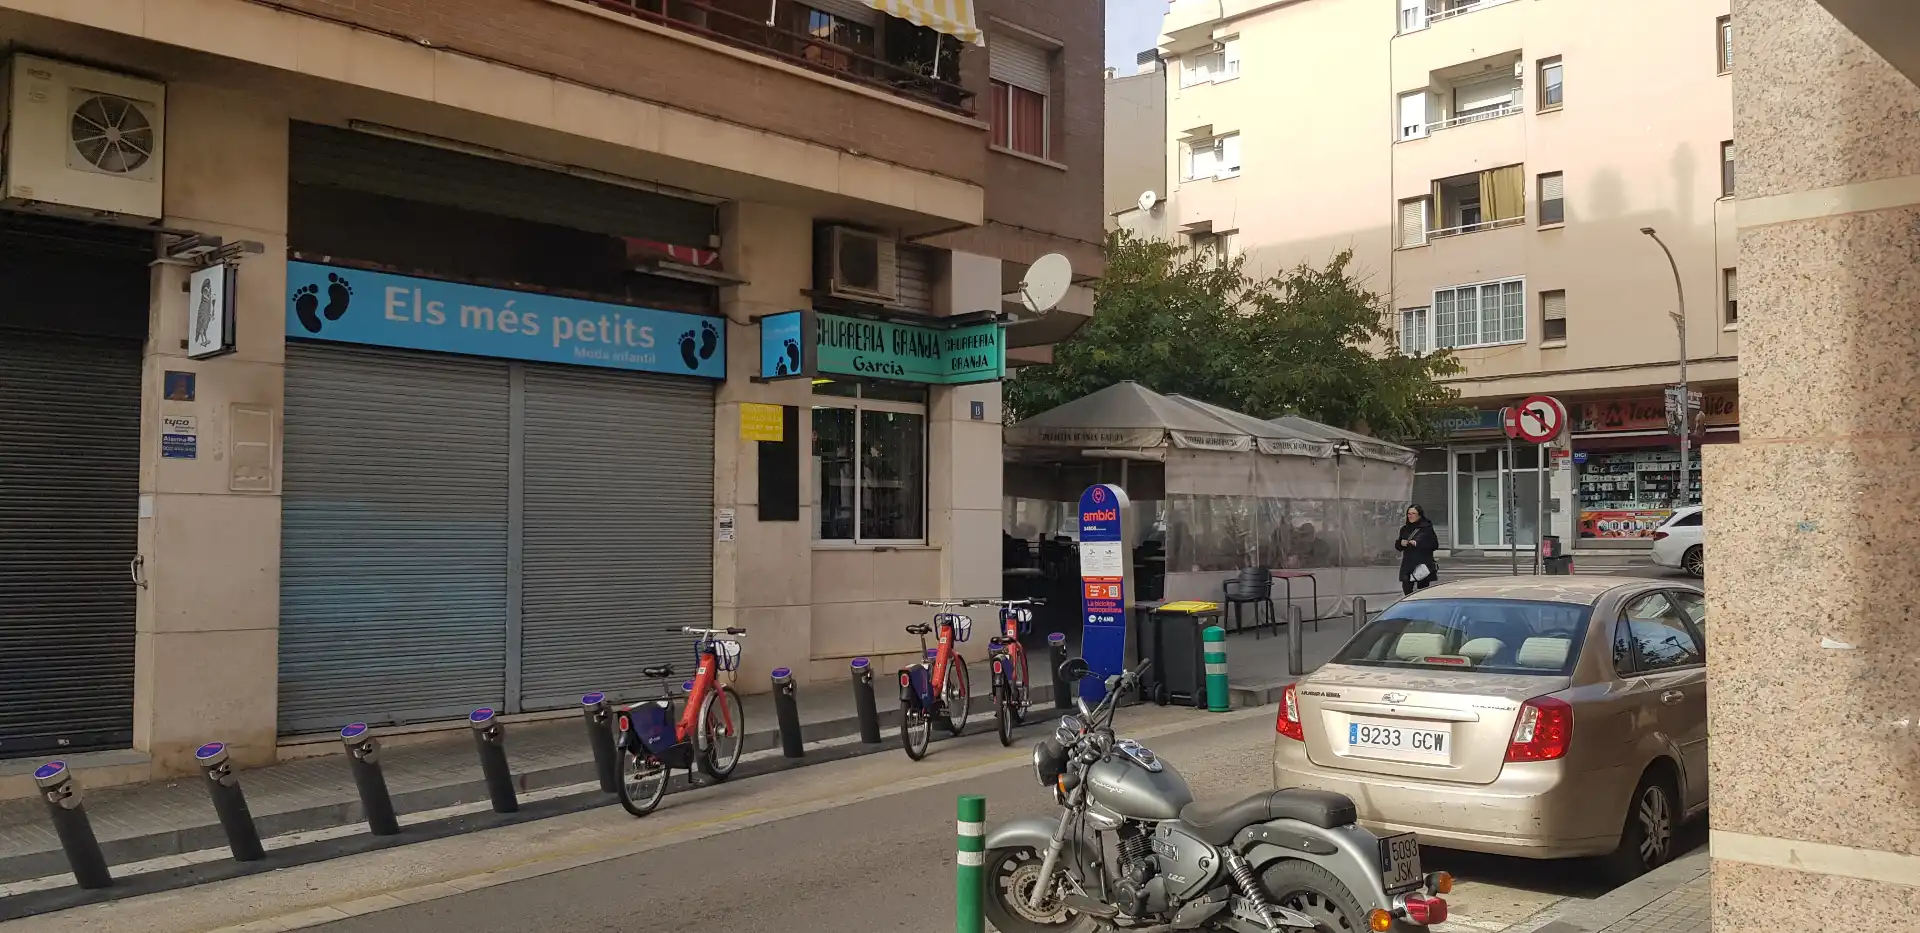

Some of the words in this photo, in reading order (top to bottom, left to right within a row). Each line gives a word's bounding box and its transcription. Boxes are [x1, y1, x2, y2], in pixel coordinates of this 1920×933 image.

[384, 286, 446, 325] Els
[460, 300, 541, 335] més
[552, 313, 655, 349] petits
[892, 329, 941, 360] GRANJA
[944, 333, 995, 352] CHURRERIA
[574, 345, 609, 362] Moda
[612, 348, 656, 366] infantil
[952, 354, 989, 371] GRANJA
[163, 418, 189, 426] tyco
[1083, 509, 1116, 521] ambici
[1360, 727, 1402, 747] 9233
[1412, 732, 1444, 752] GCW
[1391, 838, 1418, 861] 5093
[1394, 860, 1414, 882] JSK
